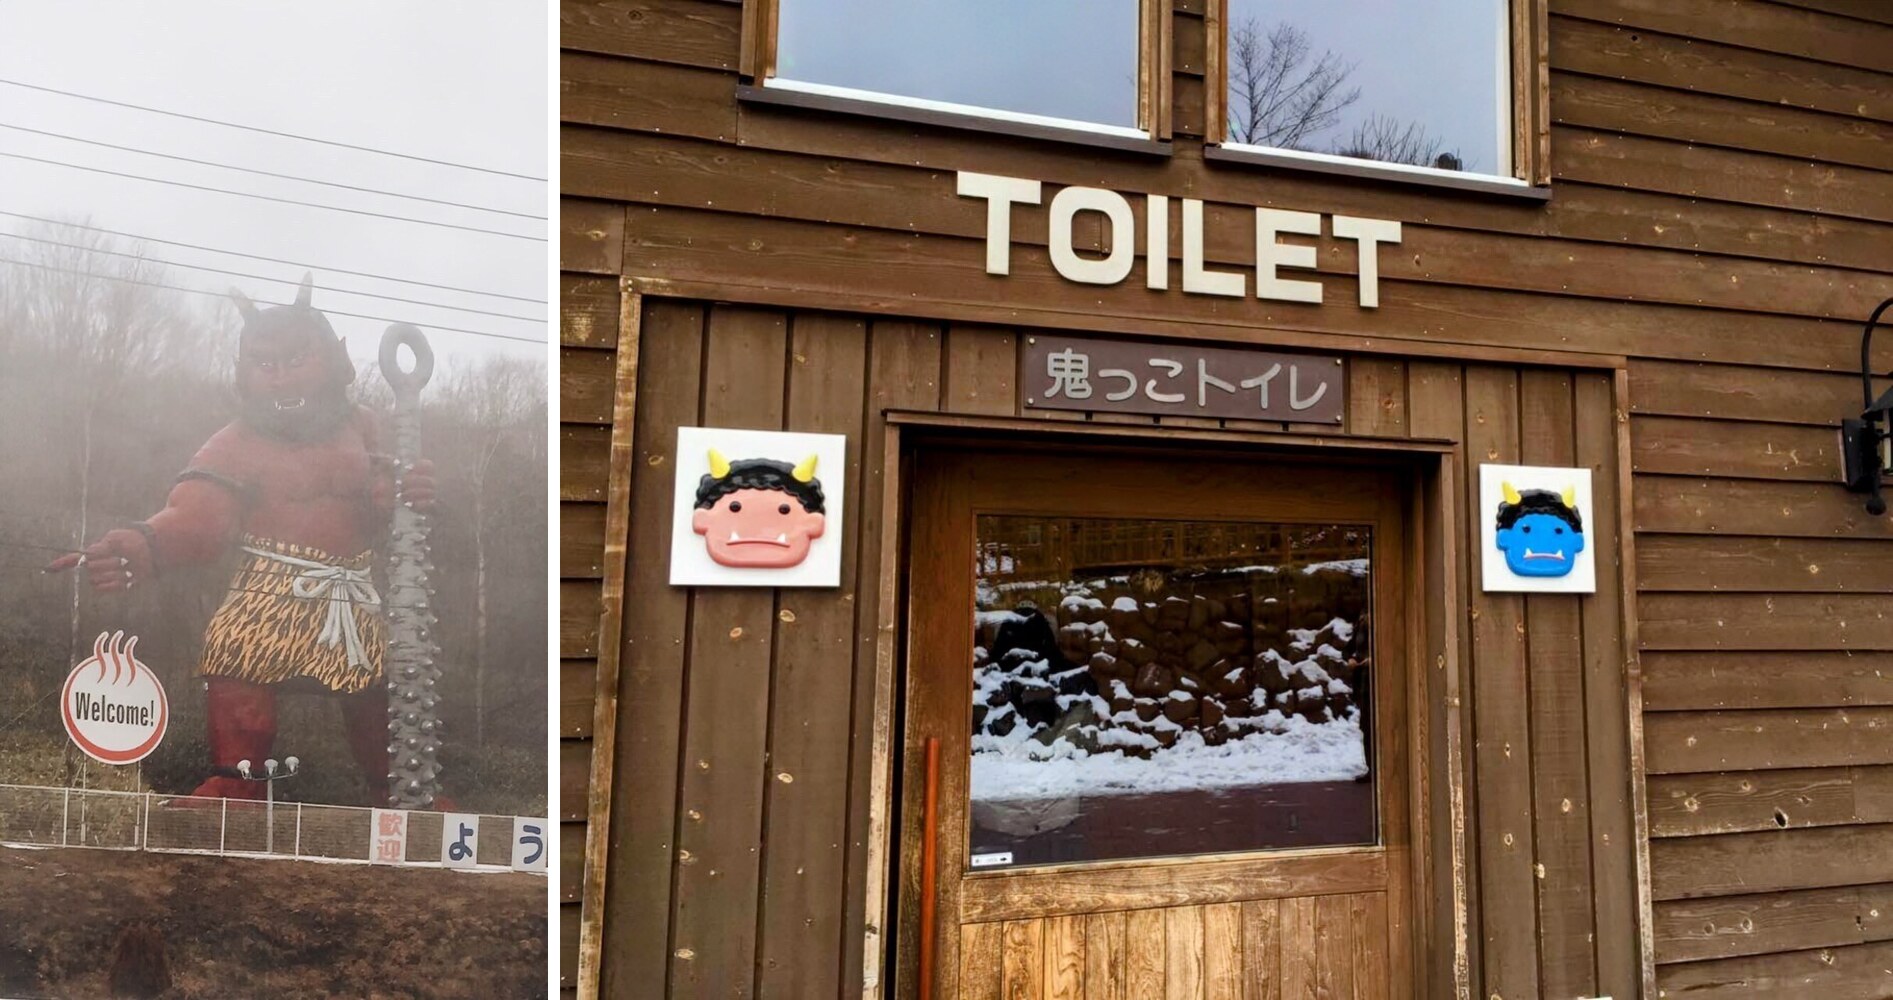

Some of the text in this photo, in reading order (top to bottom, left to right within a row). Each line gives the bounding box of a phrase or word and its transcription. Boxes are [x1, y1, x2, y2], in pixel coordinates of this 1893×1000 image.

[956, 170, 1402, 308] TOILET
[1043, 347, 1328, 410] 鬼っこトイレ
[75, 691, 154, 727] Welcome!
[377, 811, 403, 863] 歓迎
